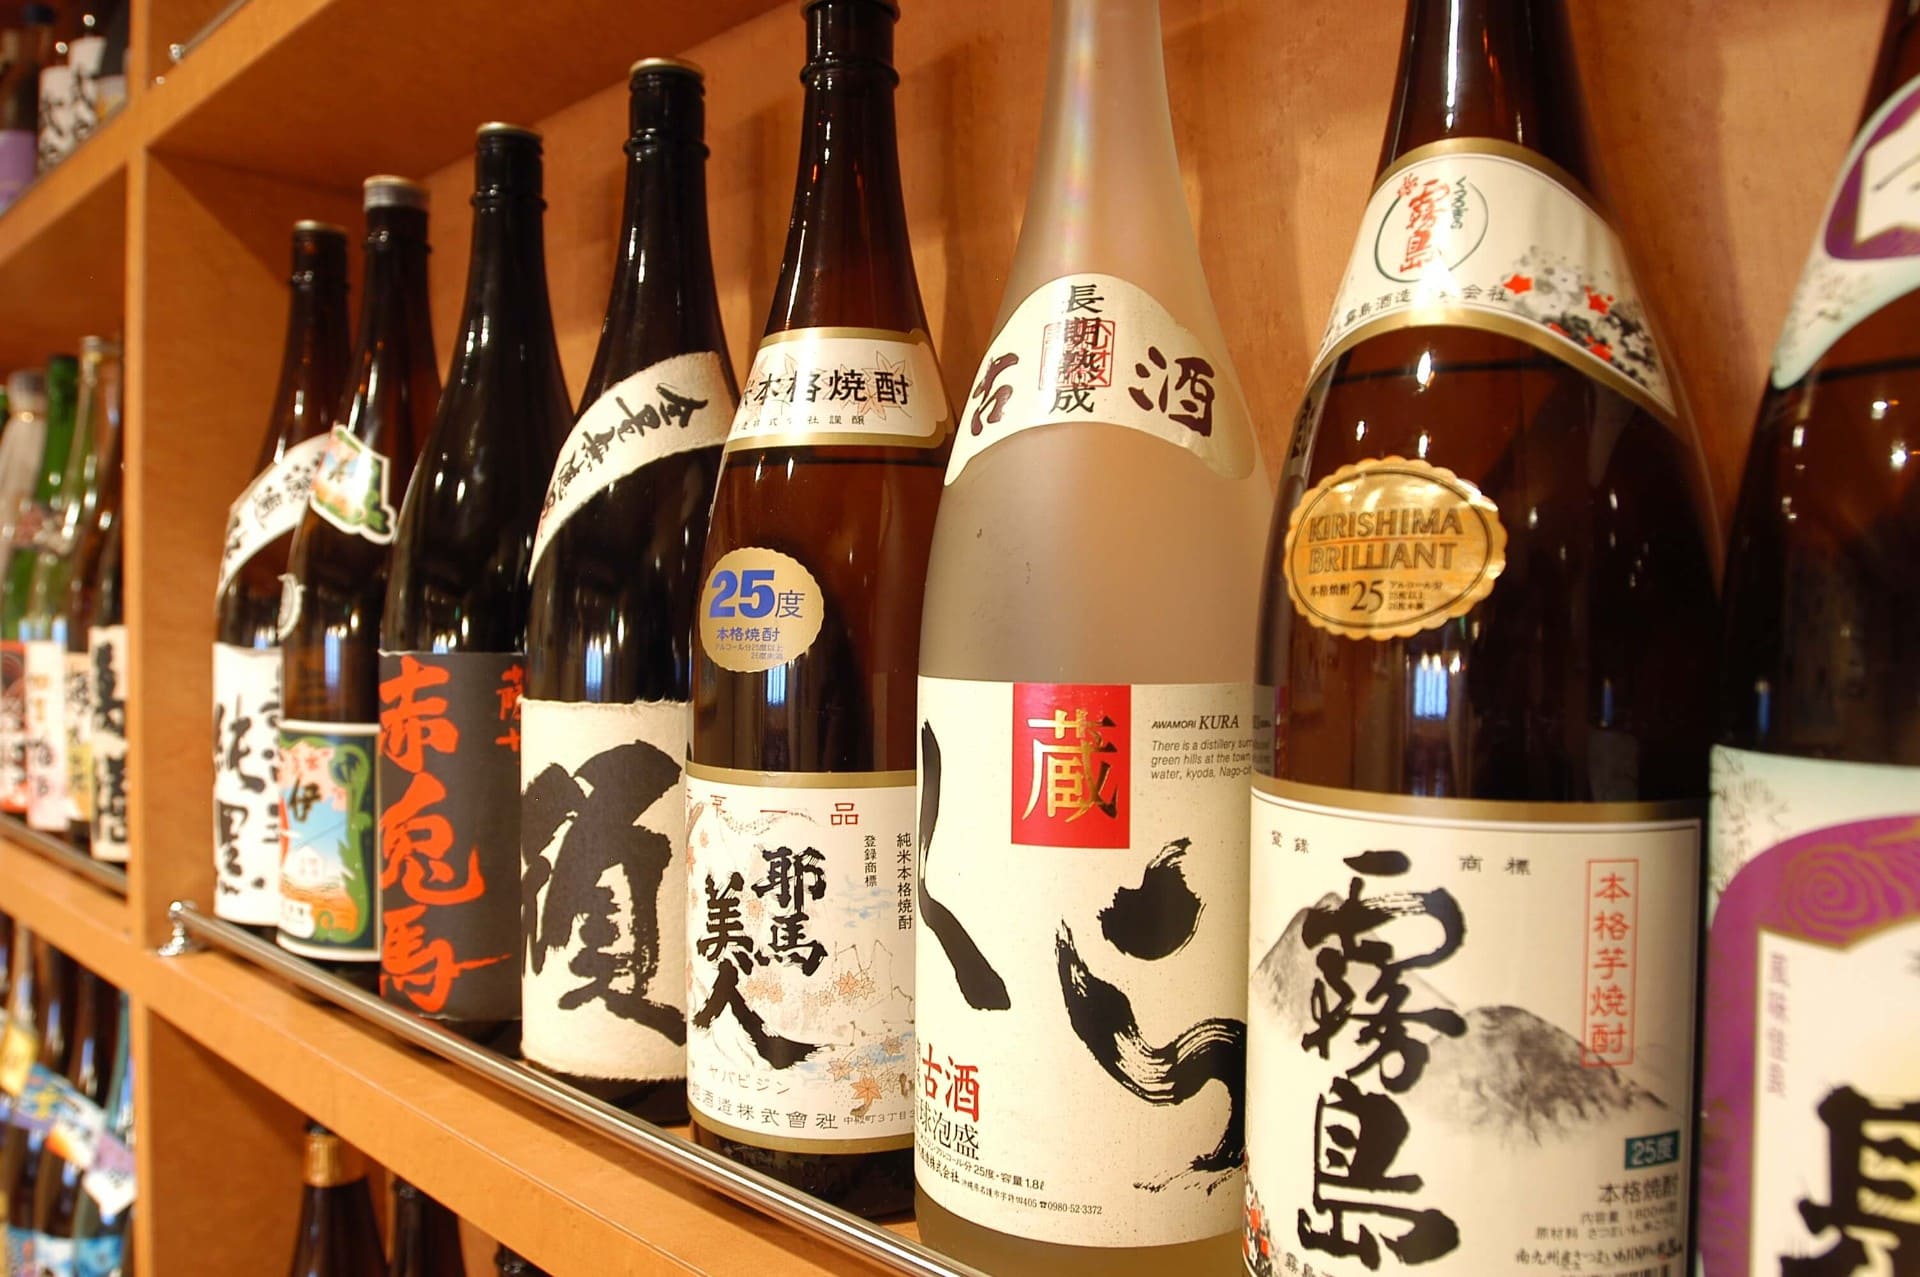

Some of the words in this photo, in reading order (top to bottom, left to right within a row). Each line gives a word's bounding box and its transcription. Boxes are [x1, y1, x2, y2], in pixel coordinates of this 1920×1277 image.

[1309, 508, 1464, 543] KIRISHIMA
[1309, 542, 1458, 575] BRILLIANT
[709, 569, 806, 619] 25度
[1351, 579, 1385, 614] 25
[716, 627, 781, 642] 本格焼酎
[1151, 719, 1197, 729] AWAMORI
[1199, 714, 1240, 730] KURA
[1151, 757, 1180, 768] green
[1183, 755, 1202, 766] hills
[1205, 754, 1214, 765] at
[1216, 753, 1230, 764] the
[1152, 740, 1180, 751] There
[1182, 740, 1190, 750] is
[1192, 742, 1198, 750] a
[1200, 738, 1235, 751] distillery
[1022, 708, 1119, 824] 蔵
[1151, 769, 1182, 780] water,
[864, 834, 878, 888] 登録商標
[896, 832, 913, 931] 純米本格焼酎
[1590, 872, 1633, 1056] 本格芋焼酎
[1298, 849, 1467, 1269] 霧島
[922, 1042, 980, 1123] 古酒
[1631, 1137, 1673, 1166] 25度
